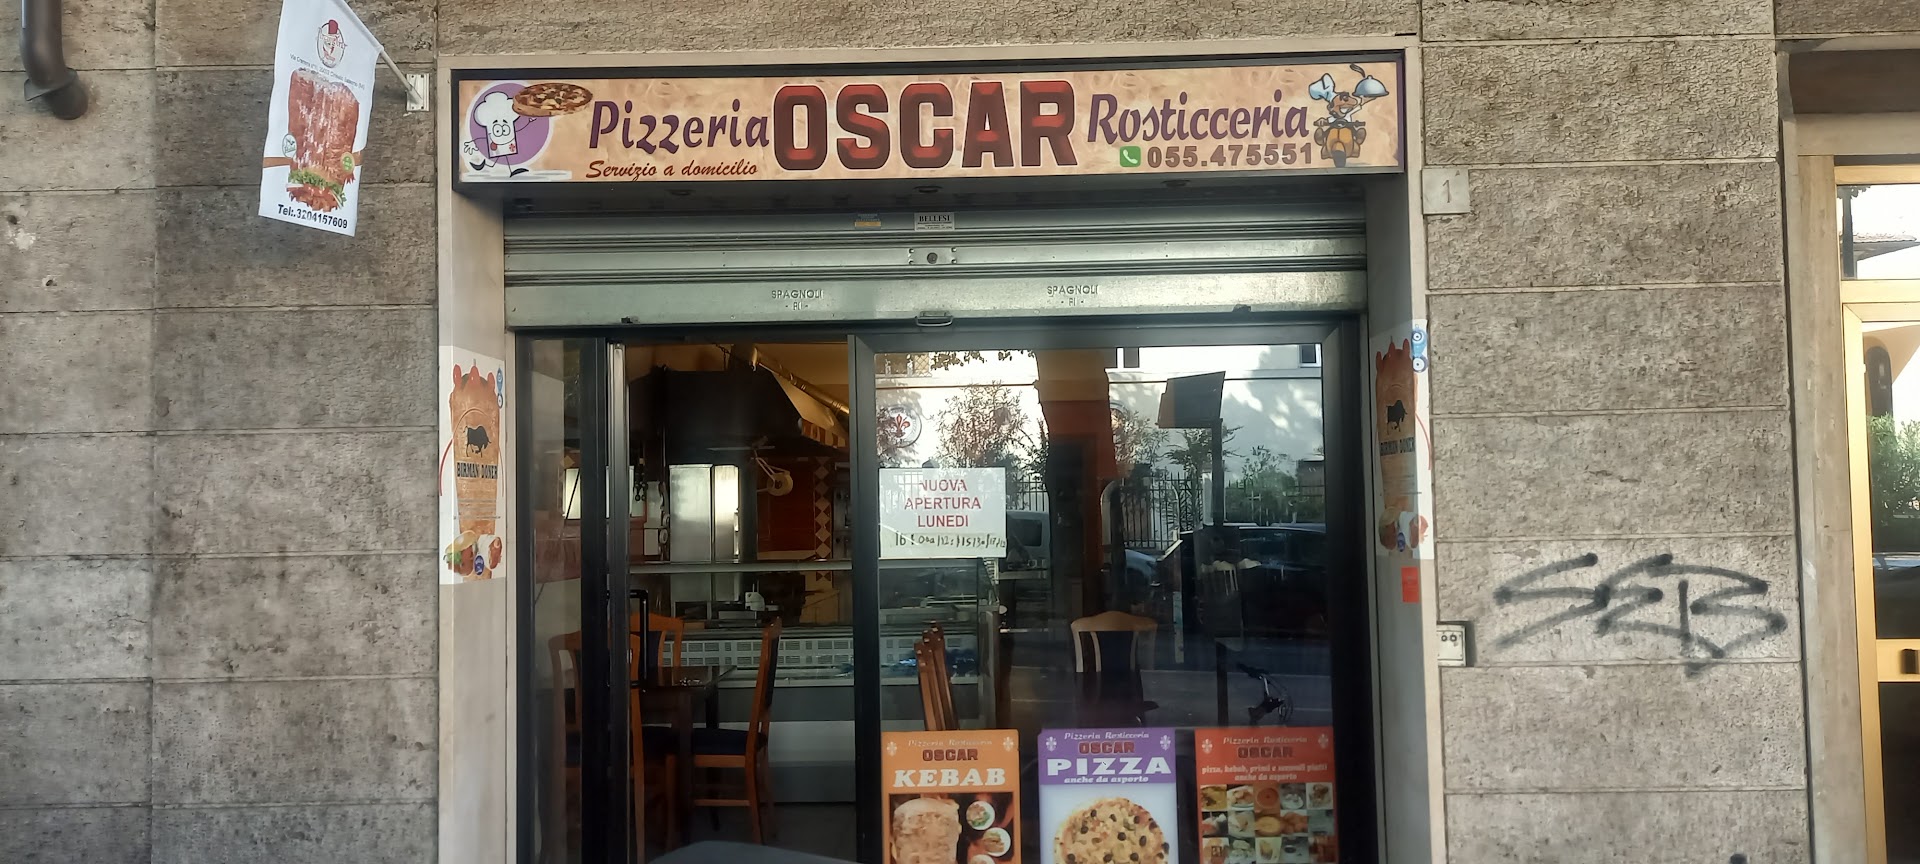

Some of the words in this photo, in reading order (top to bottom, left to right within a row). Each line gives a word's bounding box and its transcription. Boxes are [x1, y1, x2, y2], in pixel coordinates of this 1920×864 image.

[588, 98, 770, 156] Pizzeria
[772, 79, 1079, 171] OSCAR
[1087, 89, 1310, 144] Rosticceria
[1146, 143, 1313, 168] 055.475551
[585, 159, 658, 181] Servizio
[663, 165, 676, 177] a
[681, 158, 759, 177] domicilio
[1046, 284, 1099, 295] SPAGNOLI
[919, 479, 968, 492] NUOVA
[904, 497, 981, 510] APERTURA
[917, 515, 969, 528] LUNEDI
[1064, 732, 1101, 741] Pizzeria
[1078, 740, 1136, 755] OSCAR
[1237, 746, 1293, 758] OSCAR
[922, 748, 979, 762] OSCAR
[1047, 757, 1172, 776] PIZZA
[893, 768, 1006, 788] KEBAB
[1064, 776, 1094, 784] anche
[1110, 776, 1149, 784] asporto
